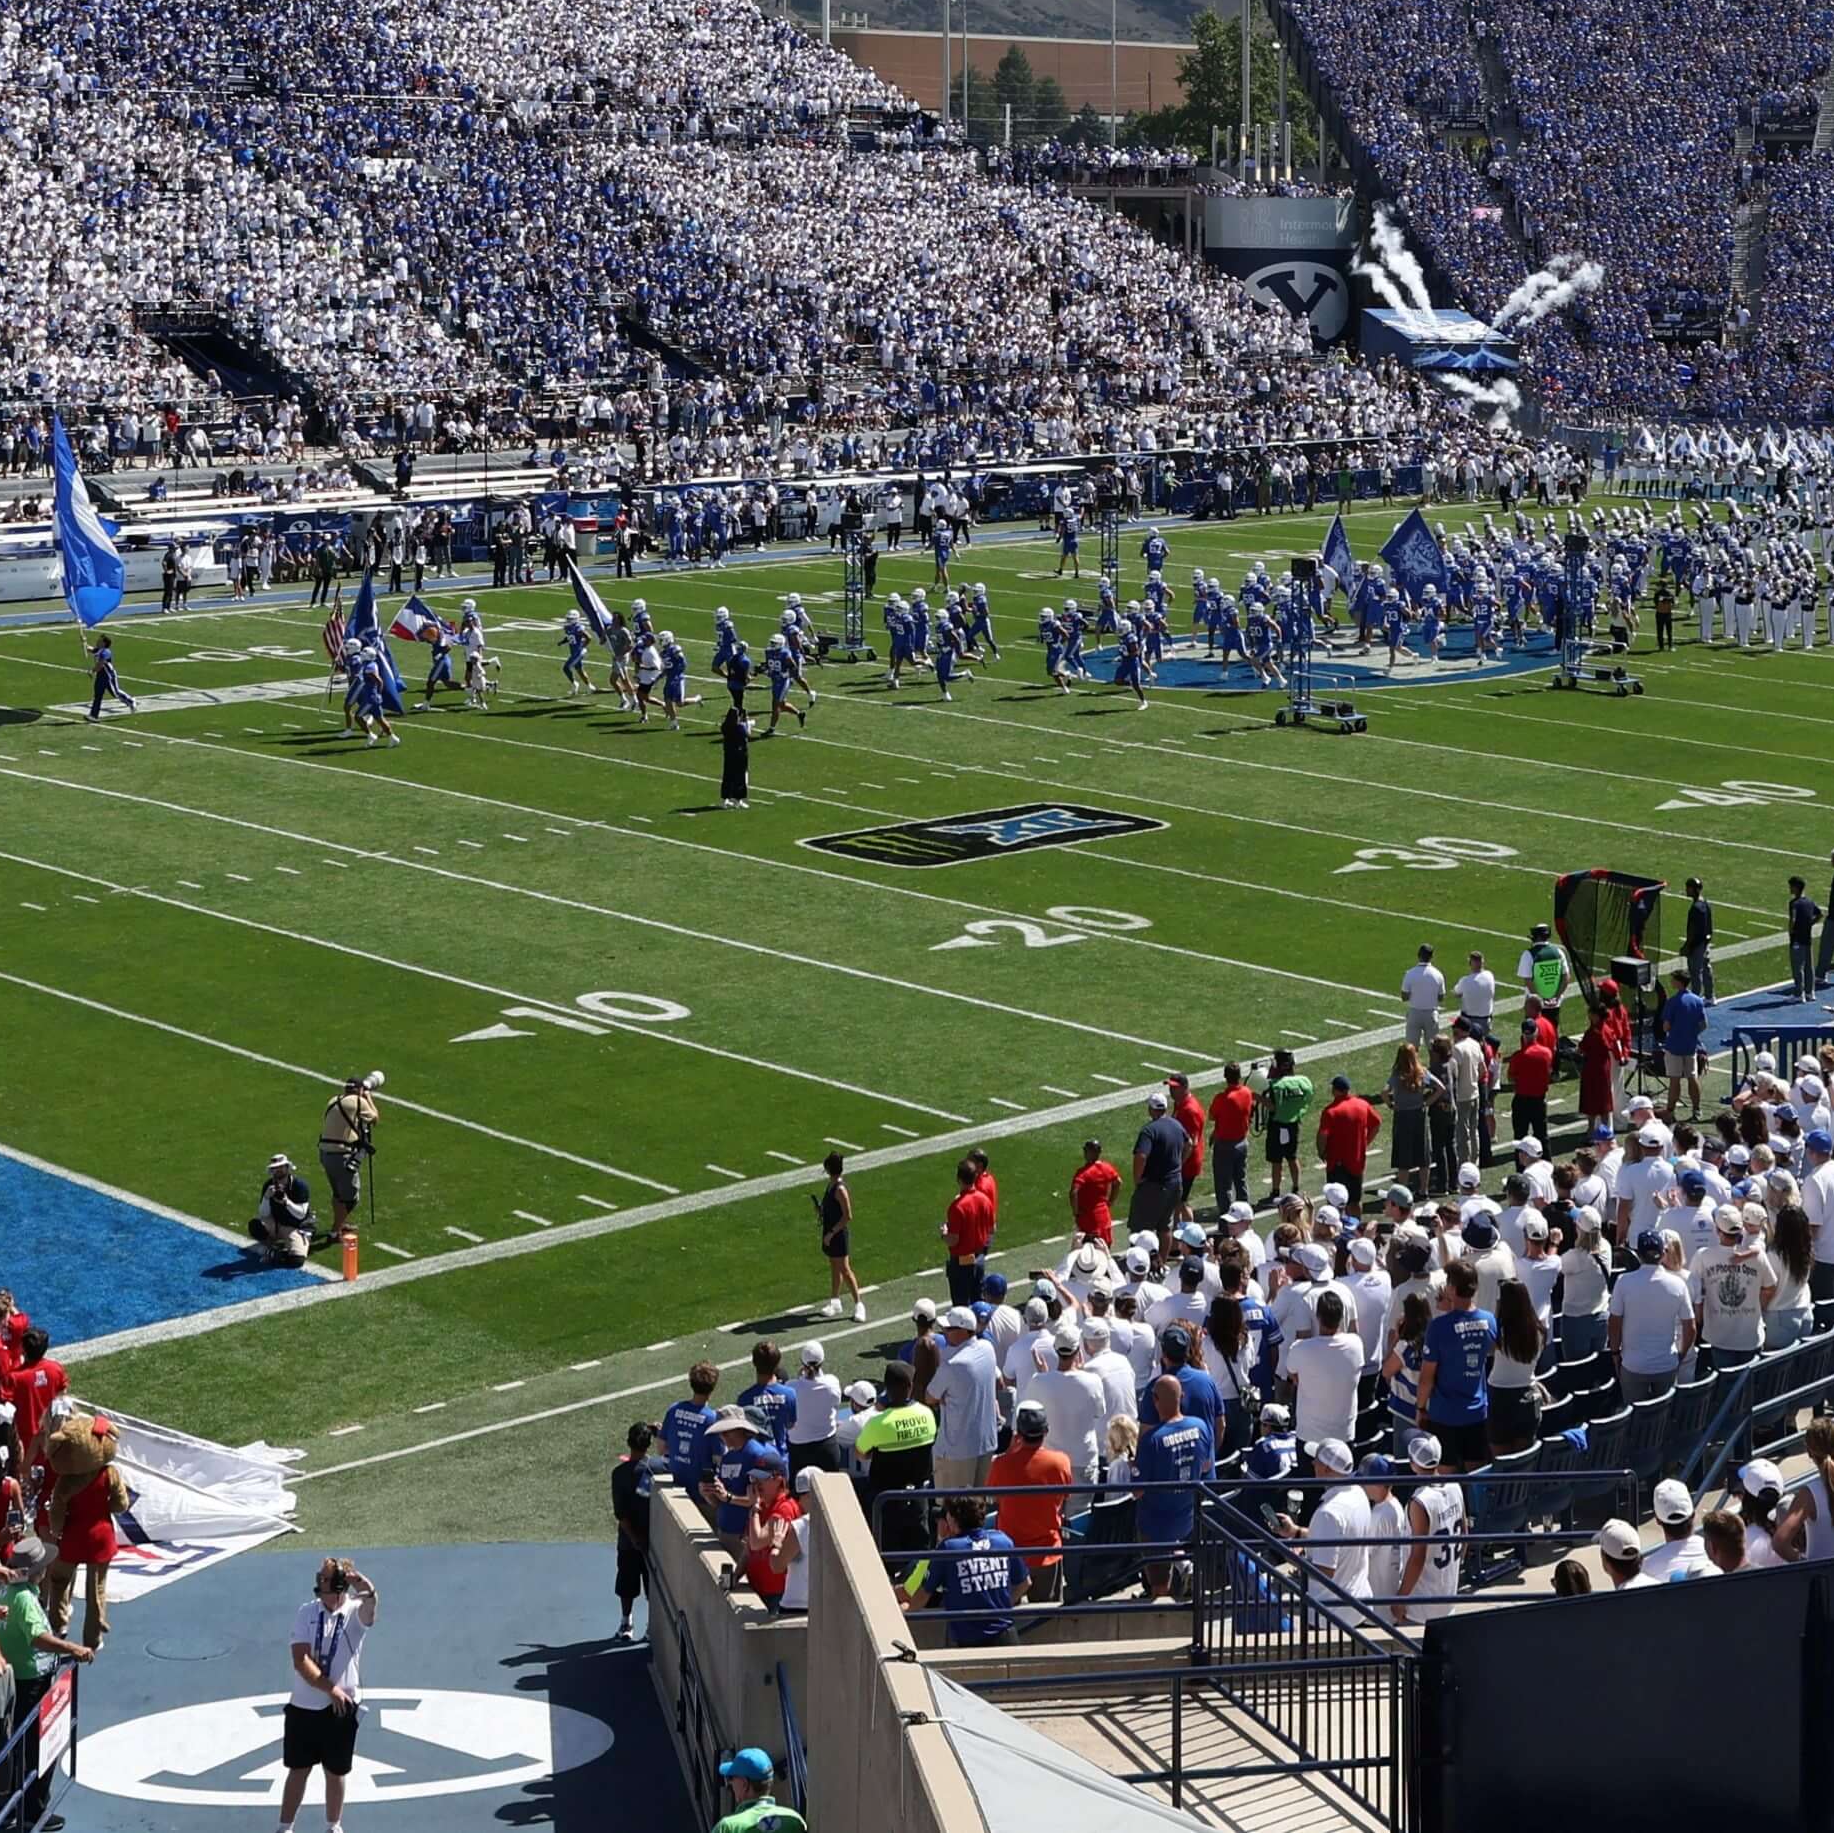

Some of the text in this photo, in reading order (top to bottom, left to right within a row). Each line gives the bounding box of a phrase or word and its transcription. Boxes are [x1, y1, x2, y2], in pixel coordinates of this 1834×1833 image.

[1680, 780, 1818, 807] 40
[1353, 836, 1520, 871] 30
[963, 904, 1154, 949] 20
[504, 990, 693, 1037] 10
[895, 1415, 928, 1431] PROVO
[955, 1556, 1010, 1577] EVENT
[961, 1572, 1009, 1595] STAFF
